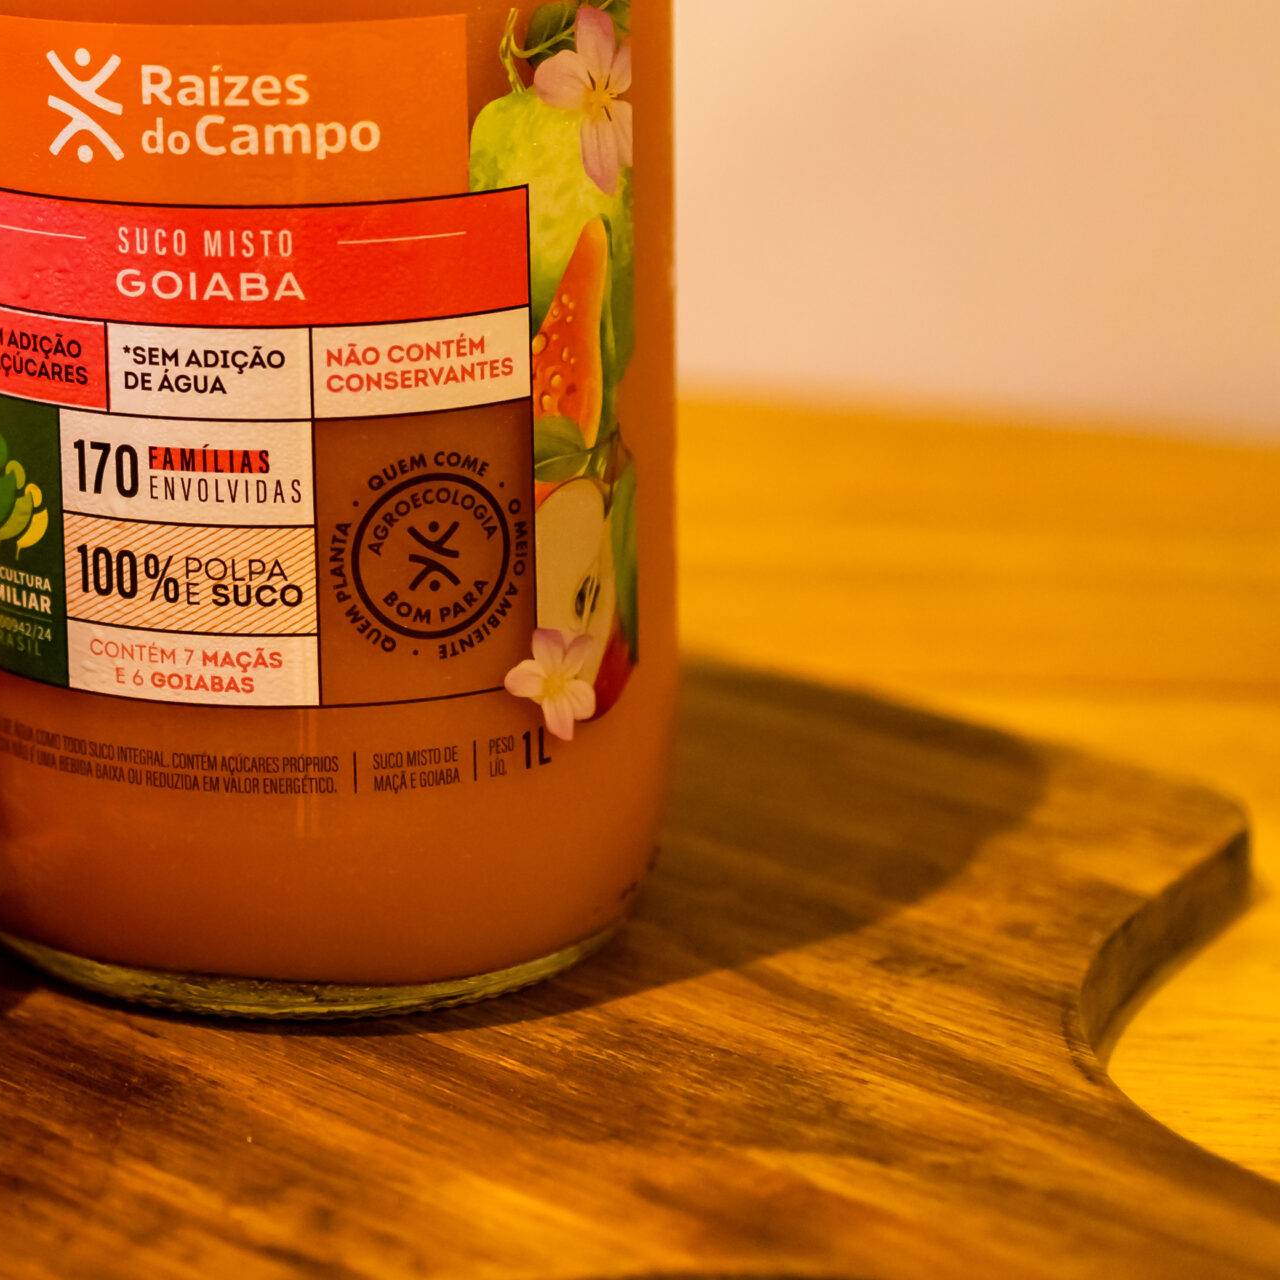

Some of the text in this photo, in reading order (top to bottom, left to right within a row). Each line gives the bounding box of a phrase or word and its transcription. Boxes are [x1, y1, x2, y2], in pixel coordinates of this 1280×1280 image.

[141, 65, 310, 107] Raízes
[118, 226, 293, 257] SUCO MISTO
[116, 268, 307, 302] GOIABA
[7, 330, 82, 359] ADIÇÃO
[185, 345, 286, 375] ADIÇÃO
[326, 332, 486, 368] NÃO CONTÉM
[124, 369, 227, 394] DE ÁGUA
[326, 357, 514, 393] CONSERVANTES
[73, 439, 139, 498] 170
[149, 444, 270, 473] FAMÍLIAS
[368, 451, 490, 492] QUEM COME
[149, 476, 302, 504] ENVOLVIDAS
[368, 487, 498, 557] AGROECOLOGIA
[77, 544, 180, 603] 100%
[185, 556, 288, 581] POLPA
[438, 499, 528, 659] O MEIO AMBIENTE
[186, 582, 303, 607] E SUCO
[329, 523, 397, 653] QUEM PLANTA
[382, 580, 489, 624] BOM PARA
[90, 638, 283, 673] CONTÉM 7 MAÇÃS
[116, 667, 255, 694] E 6 GOIABAS
[62, 735, 87, 756] TODO
[88, 741, 115, 761] SUCO
[172, 752, 217, 771] CONTÉM
[220, 753, 280, 776] AÇÚCARES
[283, 751, 339, 773] PRÓPRIOS
[373, 745, 458, 770] SUCO MISTO DE
[489, 735, 514, 756] PESO
[37, 750, 57, 769] UMA
[59, 755, 93, 777] BEBIDA
[95, 762, 126, 783] BAIXA
[128, 768, 143, 785] OU
[146, 771, 200, 792] REDUZIDA
[203, 776, 220, 792] EM
[223, 777, 260, 794] VALOR
[263, 774, 337, 795] ENERGÉTICO.
[374, 767, 460, 794] MAÇÃ E GOIABA
